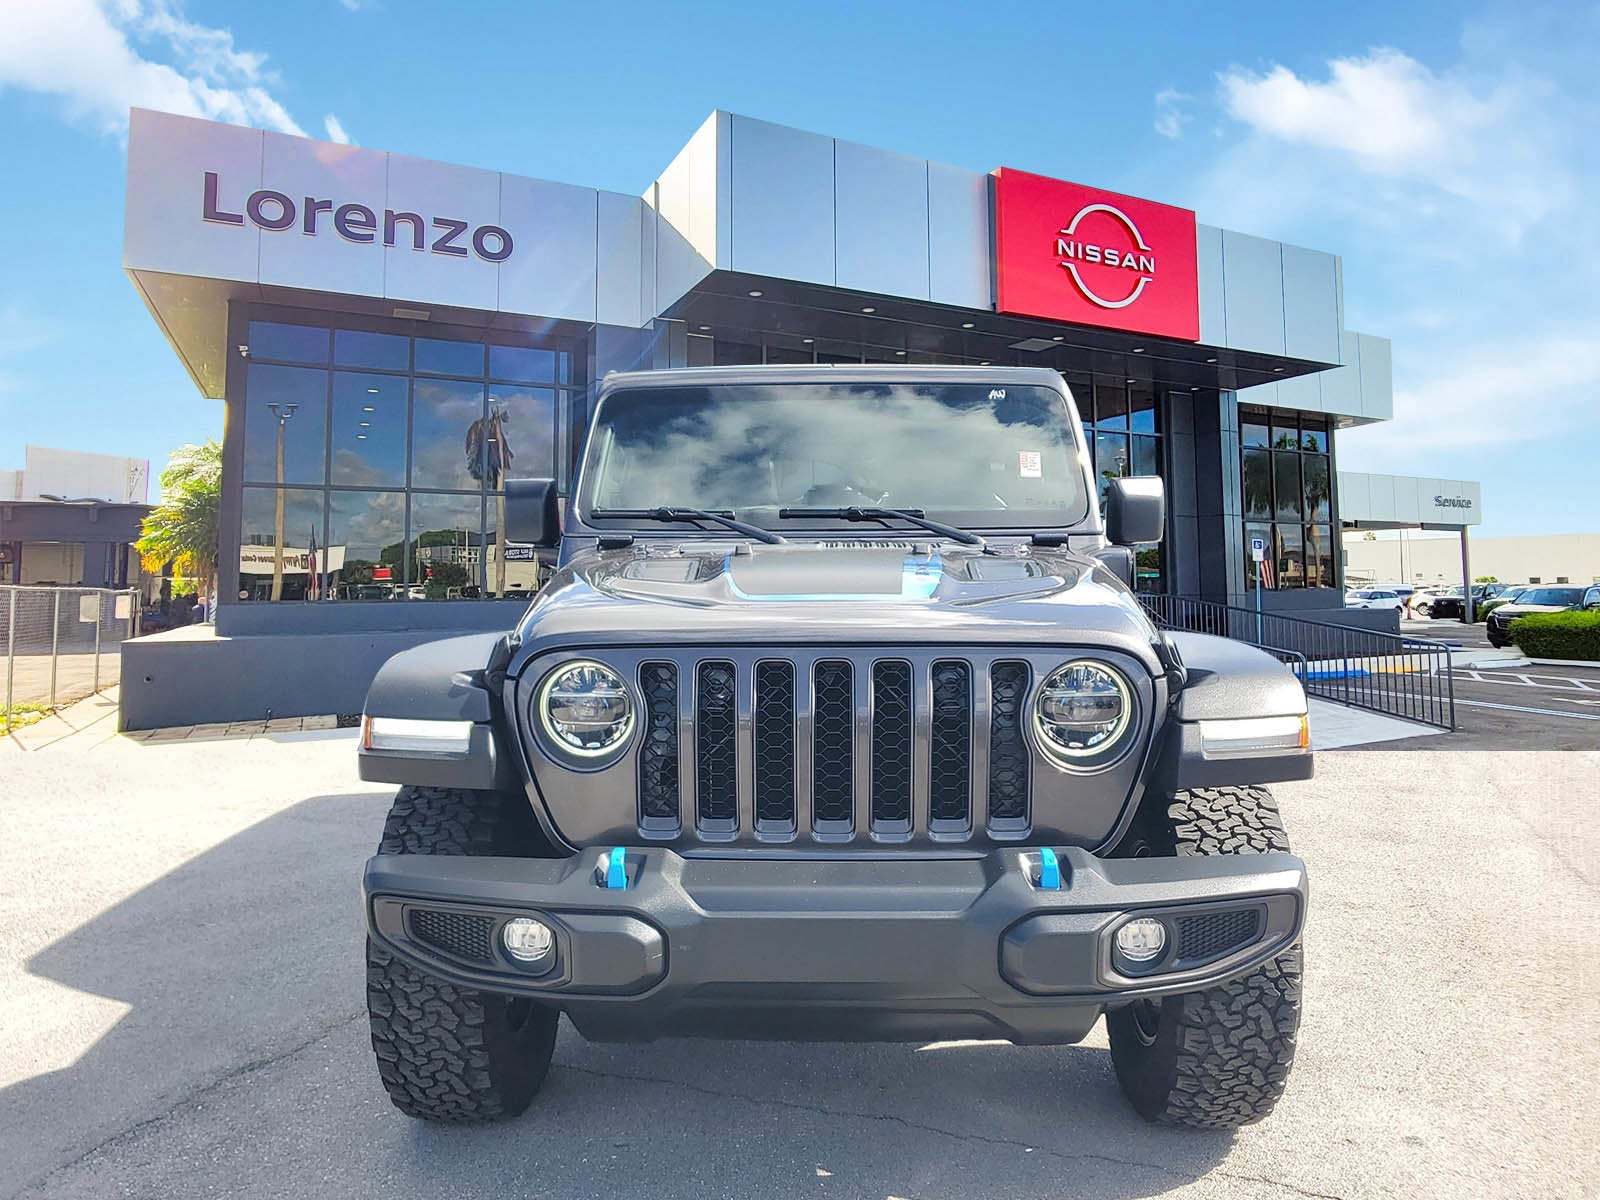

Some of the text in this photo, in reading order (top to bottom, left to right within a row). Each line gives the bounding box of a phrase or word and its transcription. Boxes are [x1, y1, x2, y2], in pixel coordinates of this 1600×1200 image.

[203, 171, 514, 262] Lorenzo
[1057, 238, 1155, 273] NISSAN
[1434, 495, 1472, 509] Service
